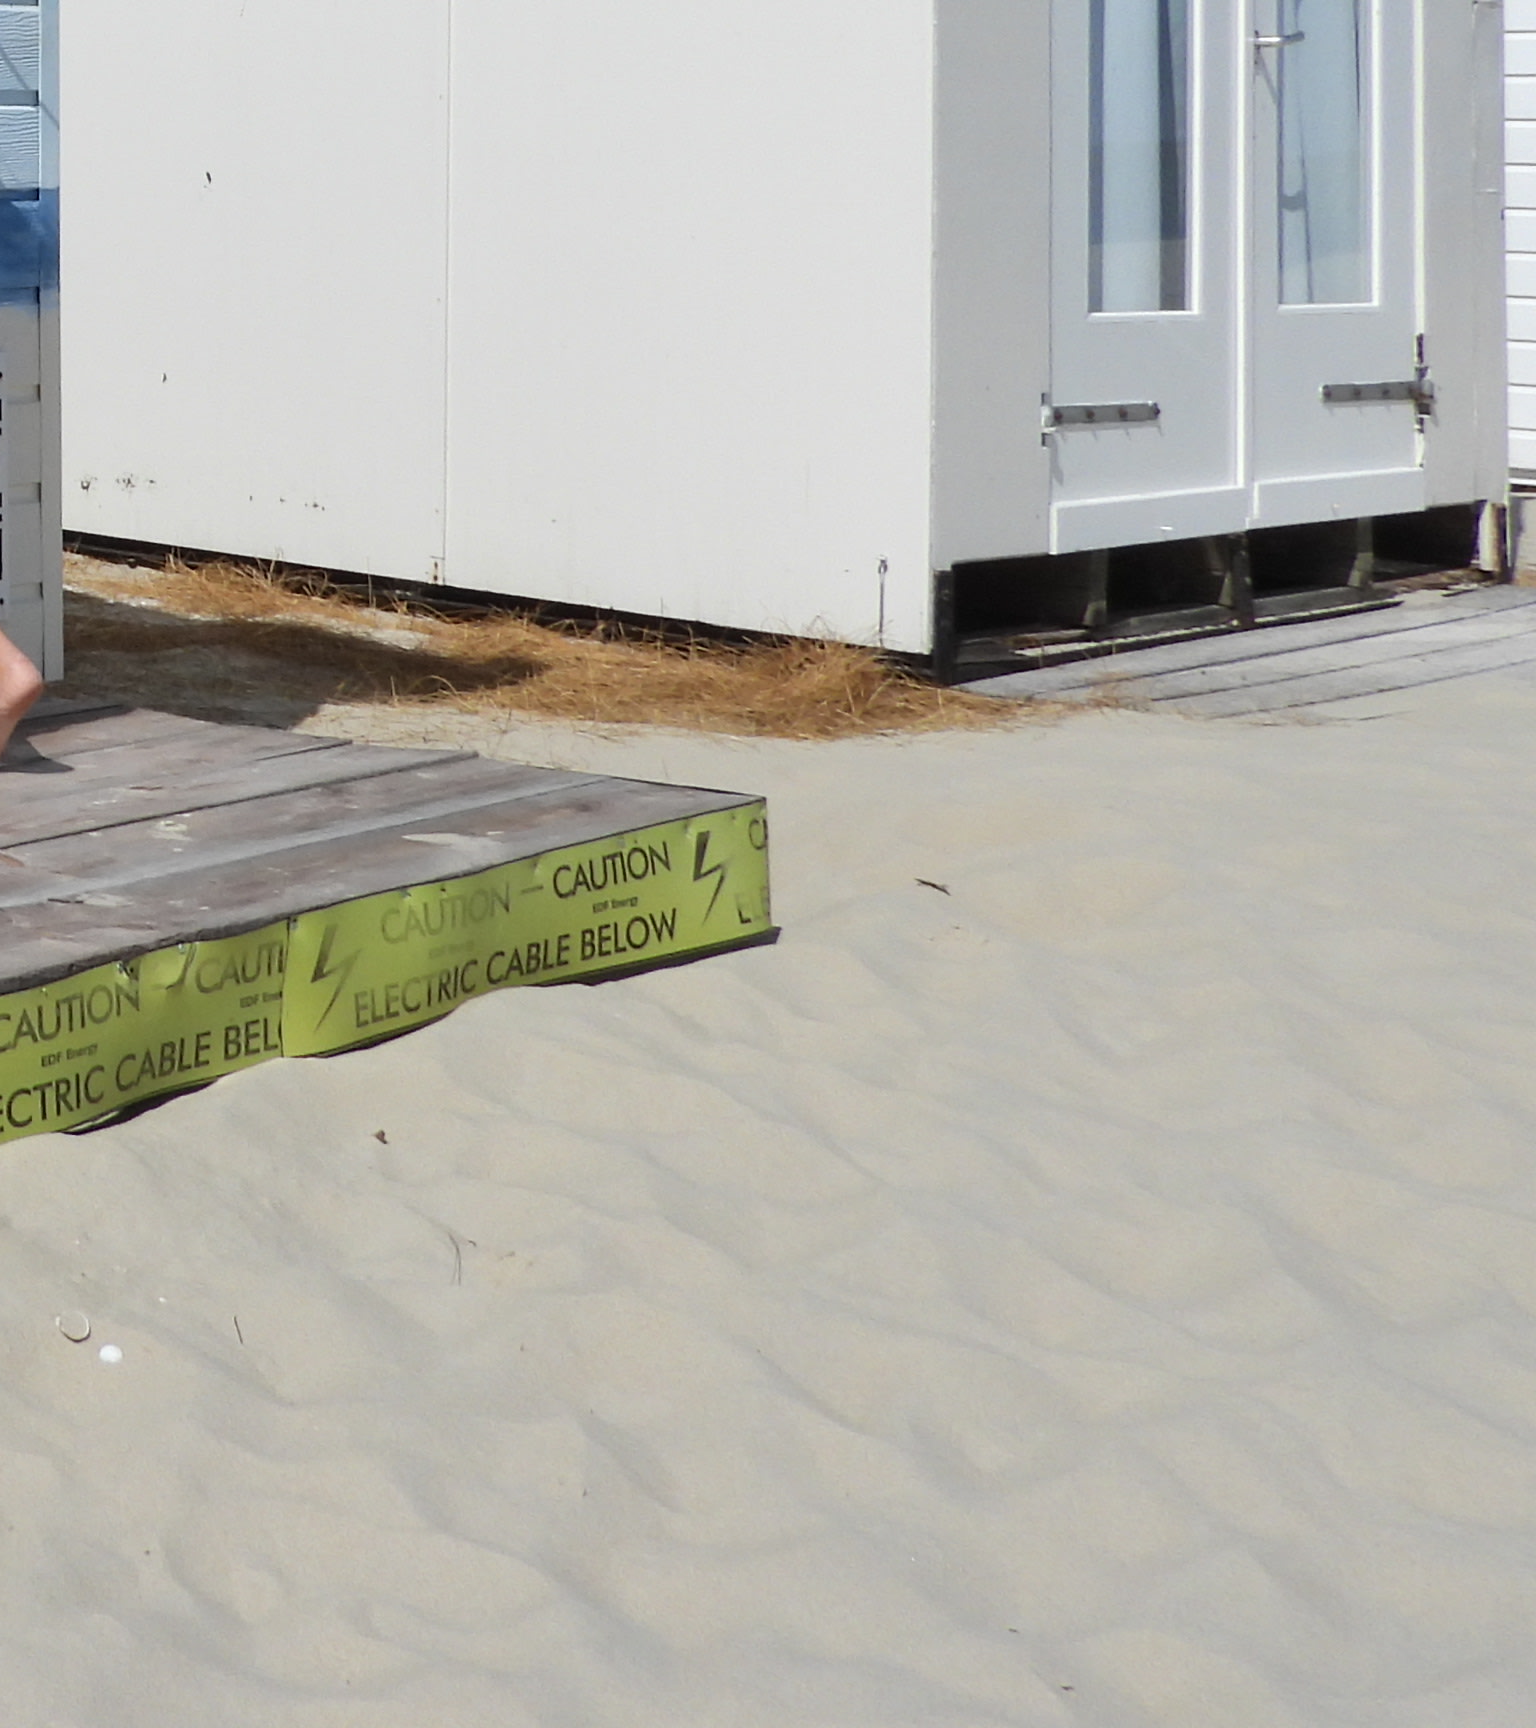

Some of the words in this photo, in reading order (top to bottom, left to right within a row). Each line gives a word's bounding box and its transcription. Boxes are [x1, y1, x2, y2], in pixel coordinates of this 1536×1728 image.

[552, 842, 671, 900] CAUTION
[381, 884, 511, 945] CAUTION
[355, 959, 477, 1029] ELECTRIC
[486, 934, 571, 985] CABLE
[580, 907, 677, 962] BELOW
[41, 1052, 64, 1068] EDF
[67, 1043, 98, 1061] Energy
[115, 1030, 212, 1093] CABLE
[224, 1017, 282, 1061] BEL
